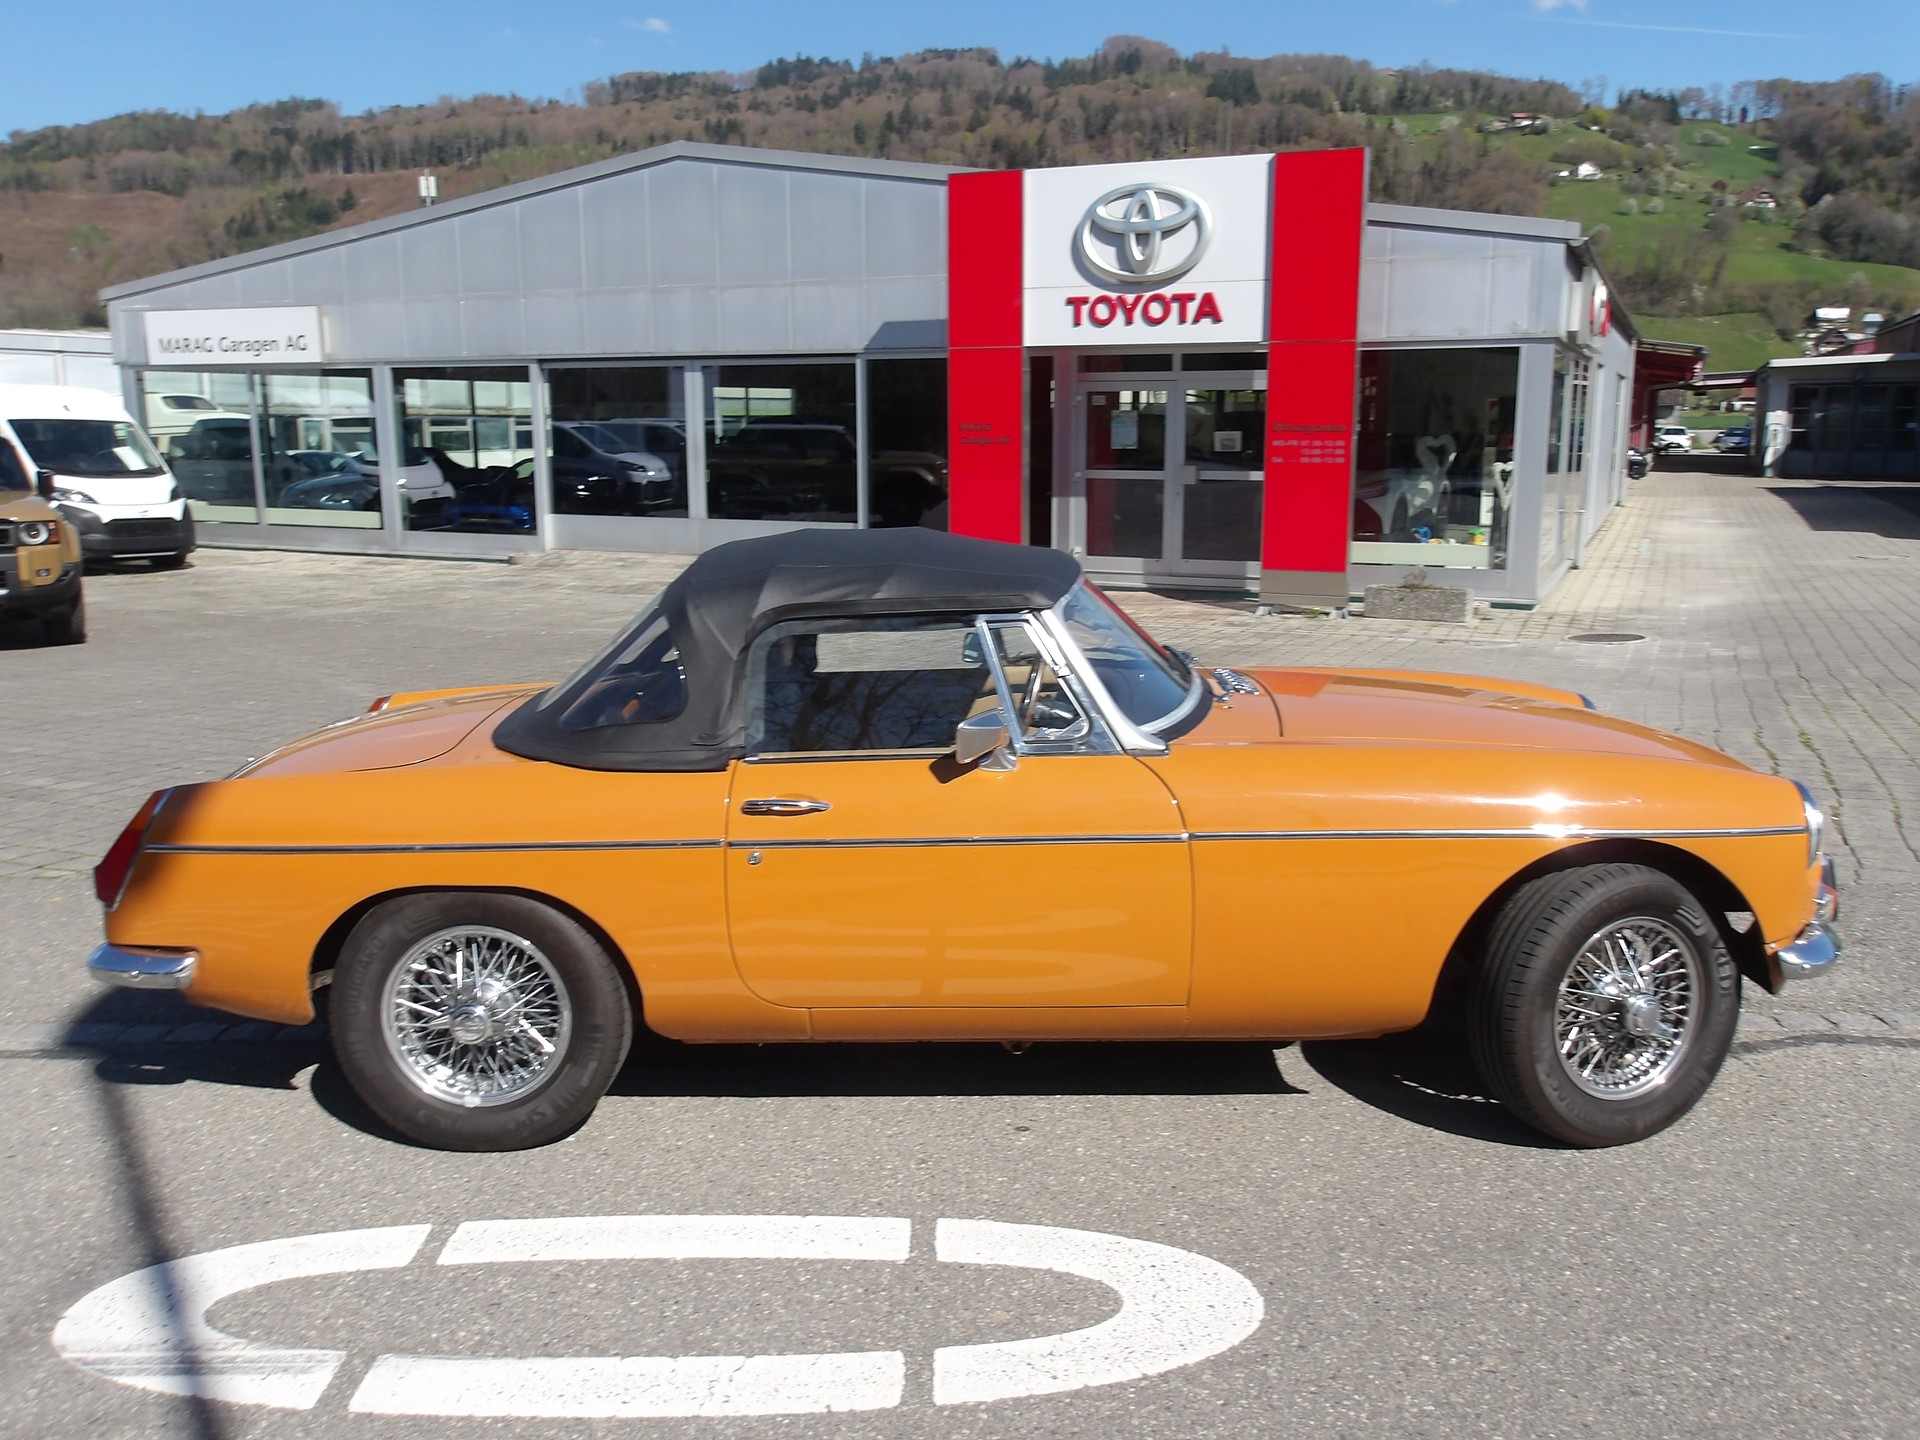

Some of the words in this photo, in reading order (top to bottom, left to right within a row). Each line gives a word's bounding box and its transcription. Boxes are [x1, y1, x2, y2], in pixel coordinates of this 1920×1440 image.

[1066, 292, 1224, 327] TOYOTA
[158, 337, 214, 354] MARAG
[218, 336, 280, 357] Garagen
[285, 335, 308, 351] AG
